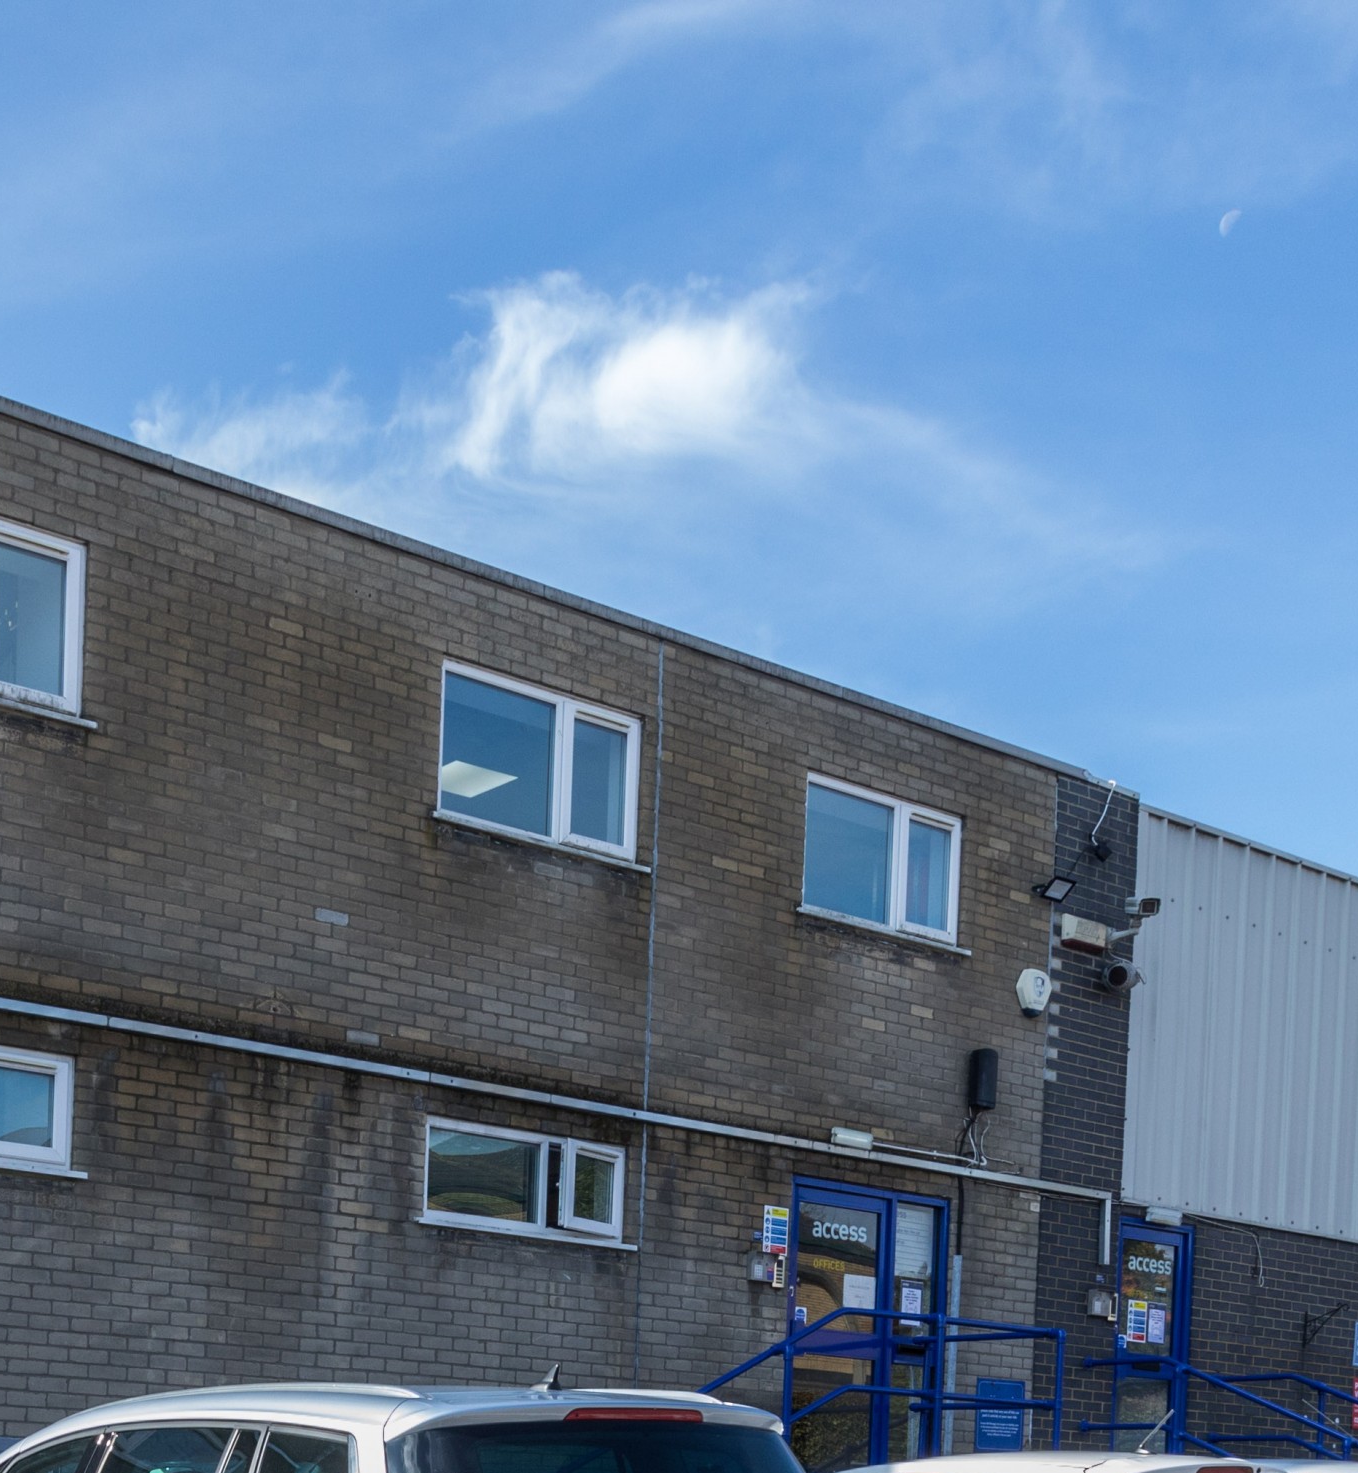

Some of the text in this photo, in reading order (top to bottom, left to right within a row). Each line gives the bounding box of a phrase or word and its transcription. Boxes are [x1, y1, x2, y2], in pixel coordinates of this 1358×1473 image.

[812, 1220, 868, 1243] access
[813, 1259, 845, 1271] OFFICES
[1128, 1255, 1172, 1275] access
